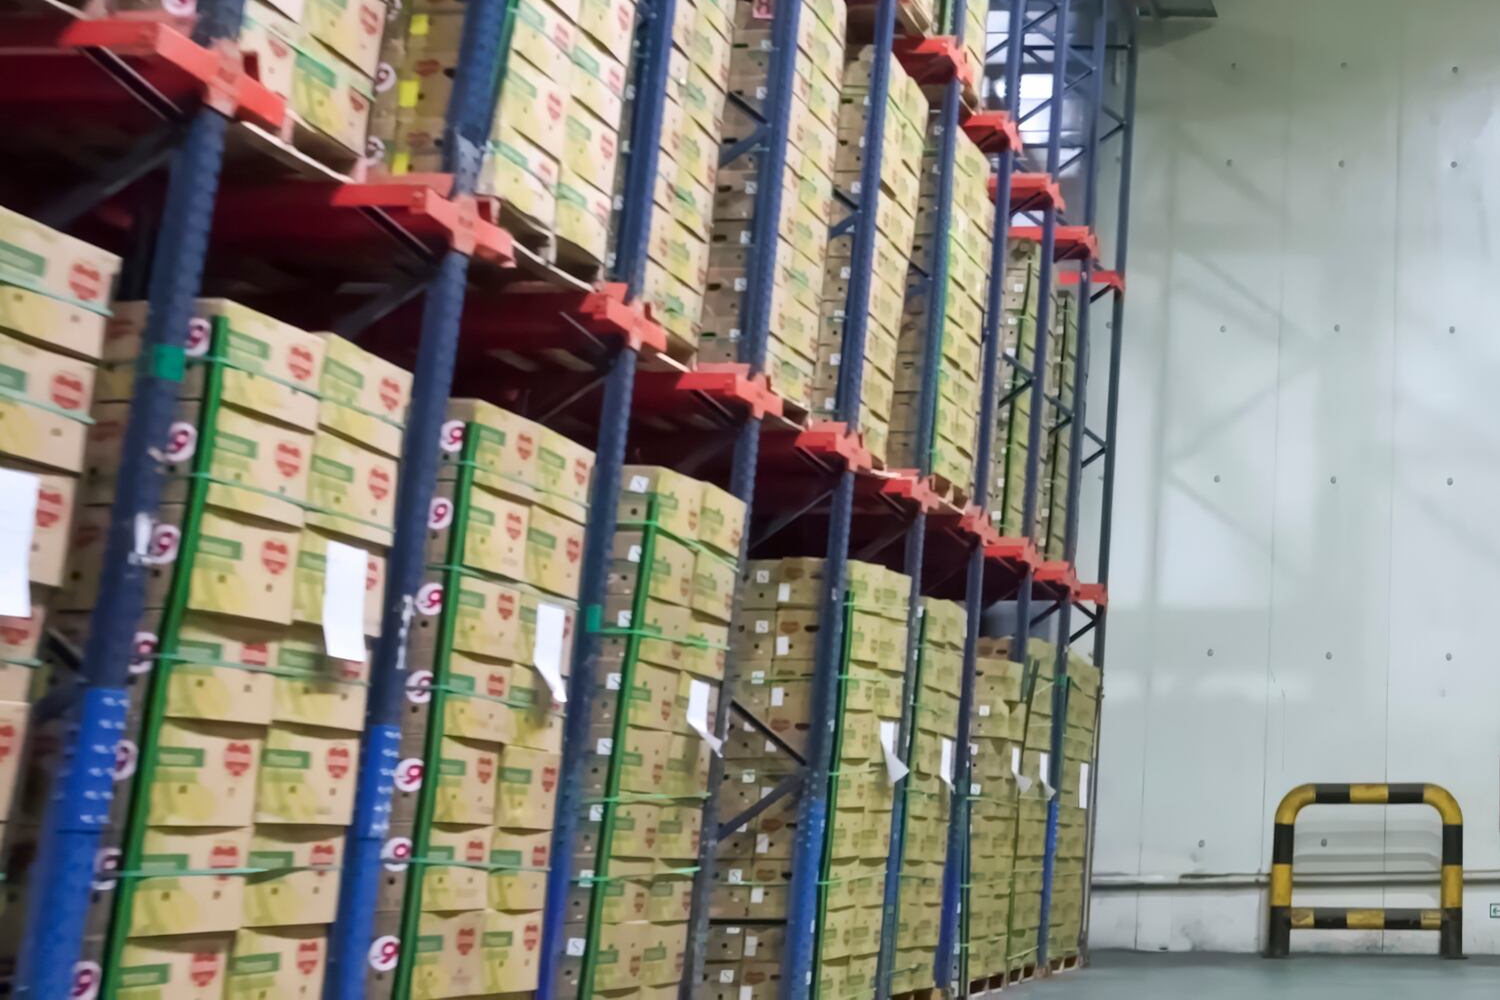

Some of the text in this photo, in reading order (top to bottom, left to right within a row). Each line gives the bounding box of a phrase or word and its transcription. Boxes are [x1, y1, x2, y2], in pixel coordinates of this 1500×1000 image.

[432, 503, 448, 523] 9
[402, 765, 423, 785] 9
[379, 941, 398, 964] 9
